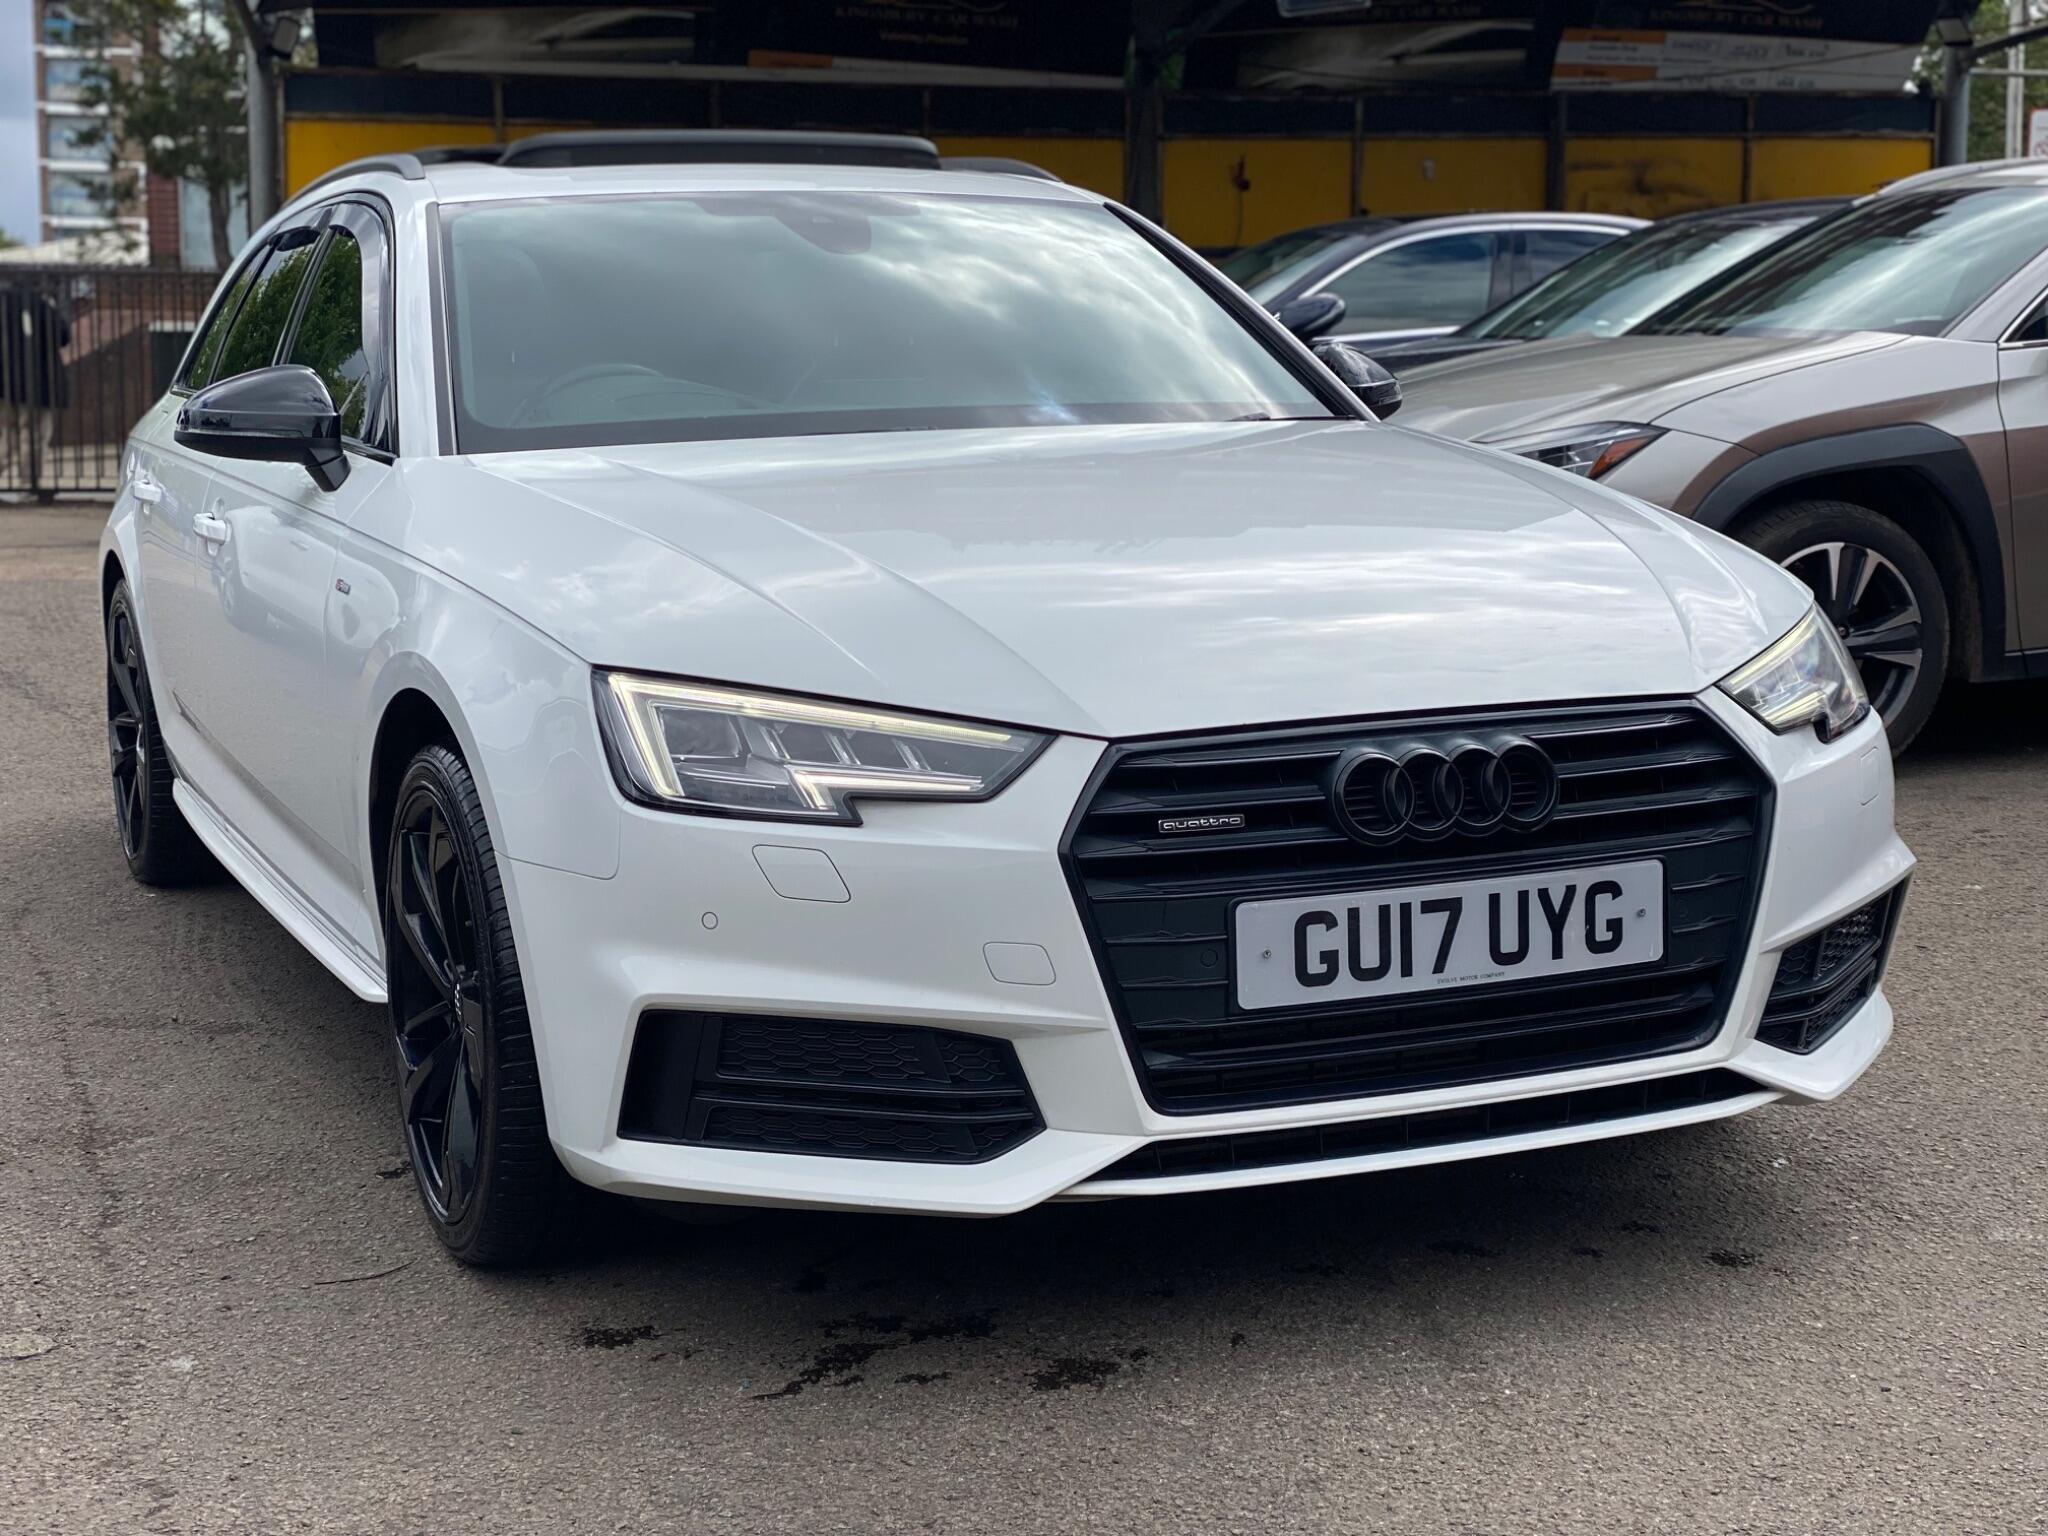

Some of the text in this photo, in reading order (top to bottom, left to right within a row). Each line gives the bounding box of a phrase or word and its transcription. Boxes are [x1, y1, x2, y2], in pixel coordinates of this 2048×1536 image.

[1163, 817, 1241, 831] quattro
[1293, 880, 1624, 988] GU17 UYG
[1480, 971, 1505, 979] COMPANY
